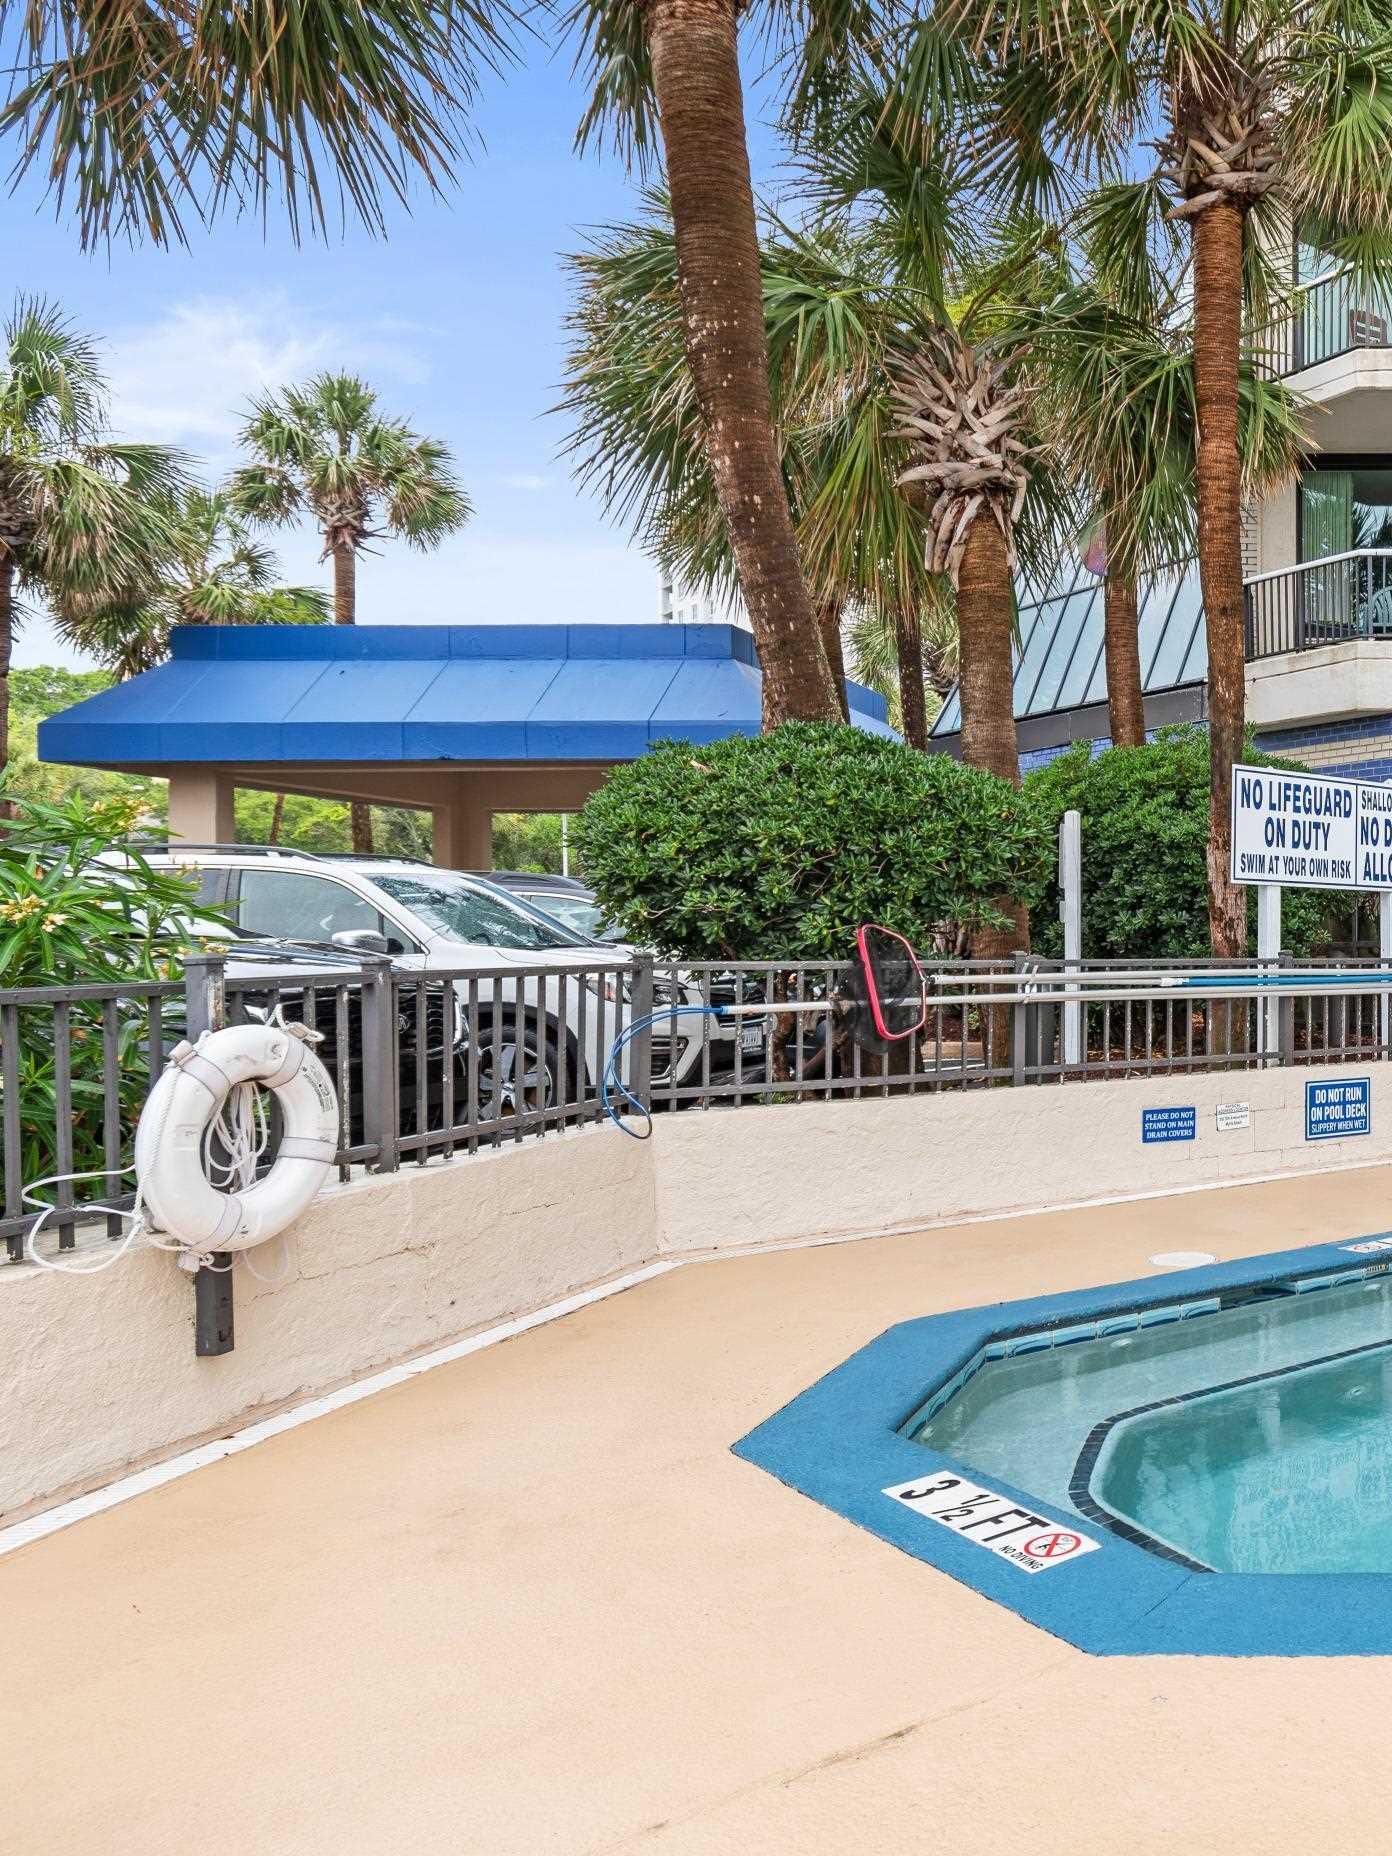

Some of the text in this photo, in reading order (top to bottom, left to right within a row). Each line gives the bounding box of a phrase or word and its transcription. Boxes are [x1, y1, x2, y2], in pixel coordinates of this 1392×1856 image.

[1241, 778, 1353, 818] NO LIFEGUARD
[1264, 816, 1331, 852] ON DUTY
[1360, 816, 1379, 847] NO
[1240, 852, 1352, 879] SWIM AT YOUR OWN RISK
[1315, 1086, 1362, 1104] DO NOT RUN
[1180, 1111, 1194, 1119] NOT
[1311, 1102, 1367, 1121] ON POOL DECK
[1144, 1120, 1194, 1130] STAND ON MAIN
[1146, 1129, 1193, 1139] DRAIN COVERS
[1311, 1118, 1366, 1133] SLIPPERY WHEN WET
[899, 1479, 961, 1500] 3
[960, 1508, 1051, 1542] FT
[1000, 1545, 1044, 1570] NO DIVING
